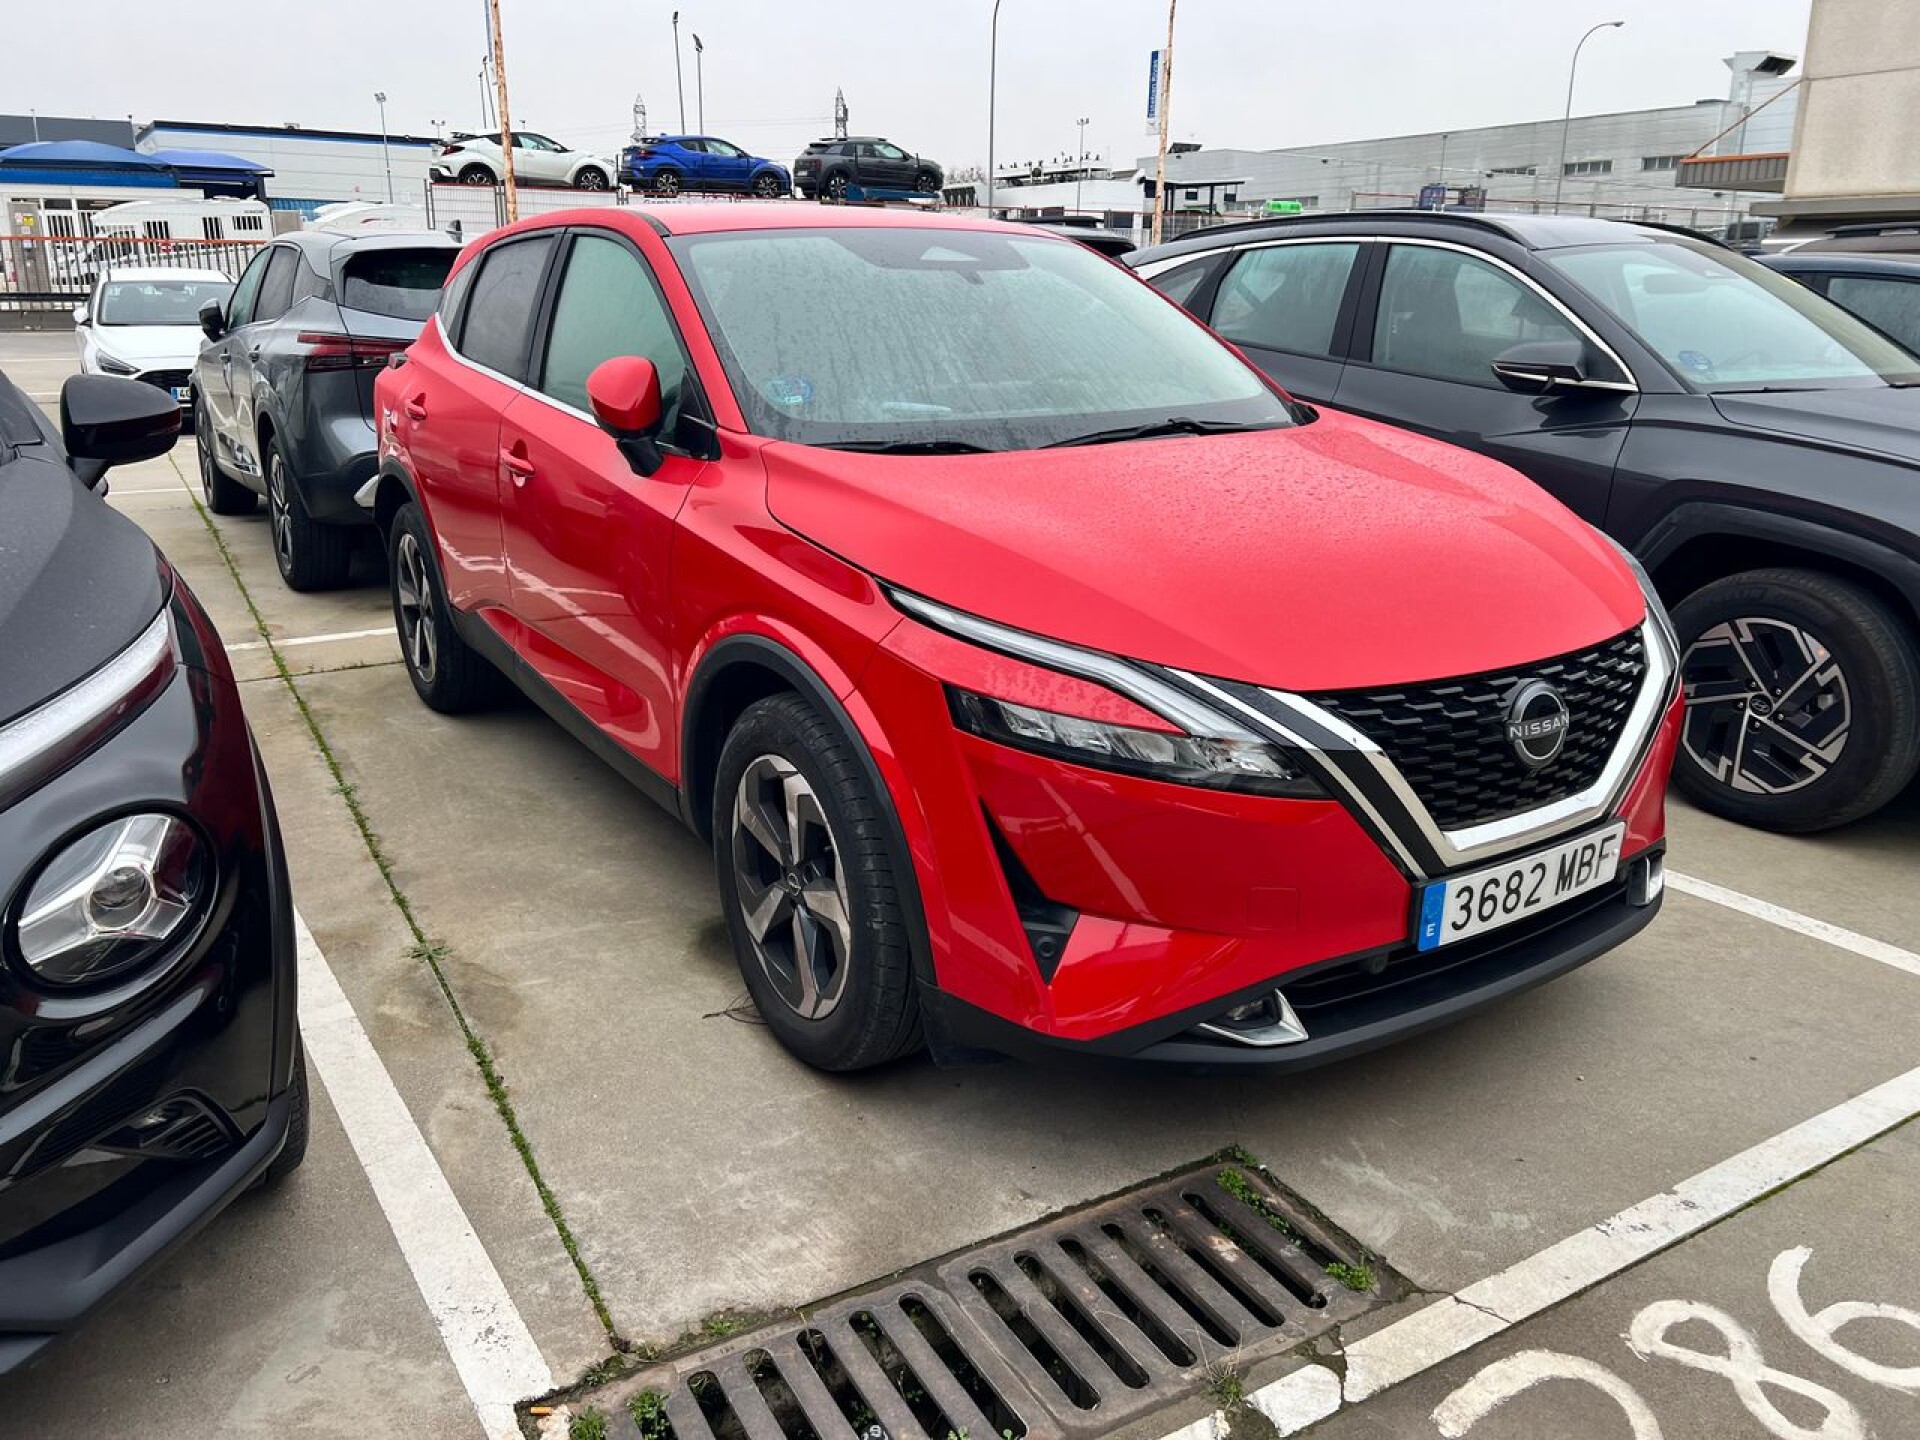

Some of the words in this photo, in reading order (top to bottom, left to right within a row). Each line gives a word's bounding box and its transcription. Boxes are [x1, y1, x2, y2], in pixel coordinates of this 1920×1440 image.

[1510, 713, 1569, 738] NISSAN
[1451, 863, 1547, 931] 3682
[1555, 833, 1617, 896] MBF
[1426, 923, 1436, 937] E
